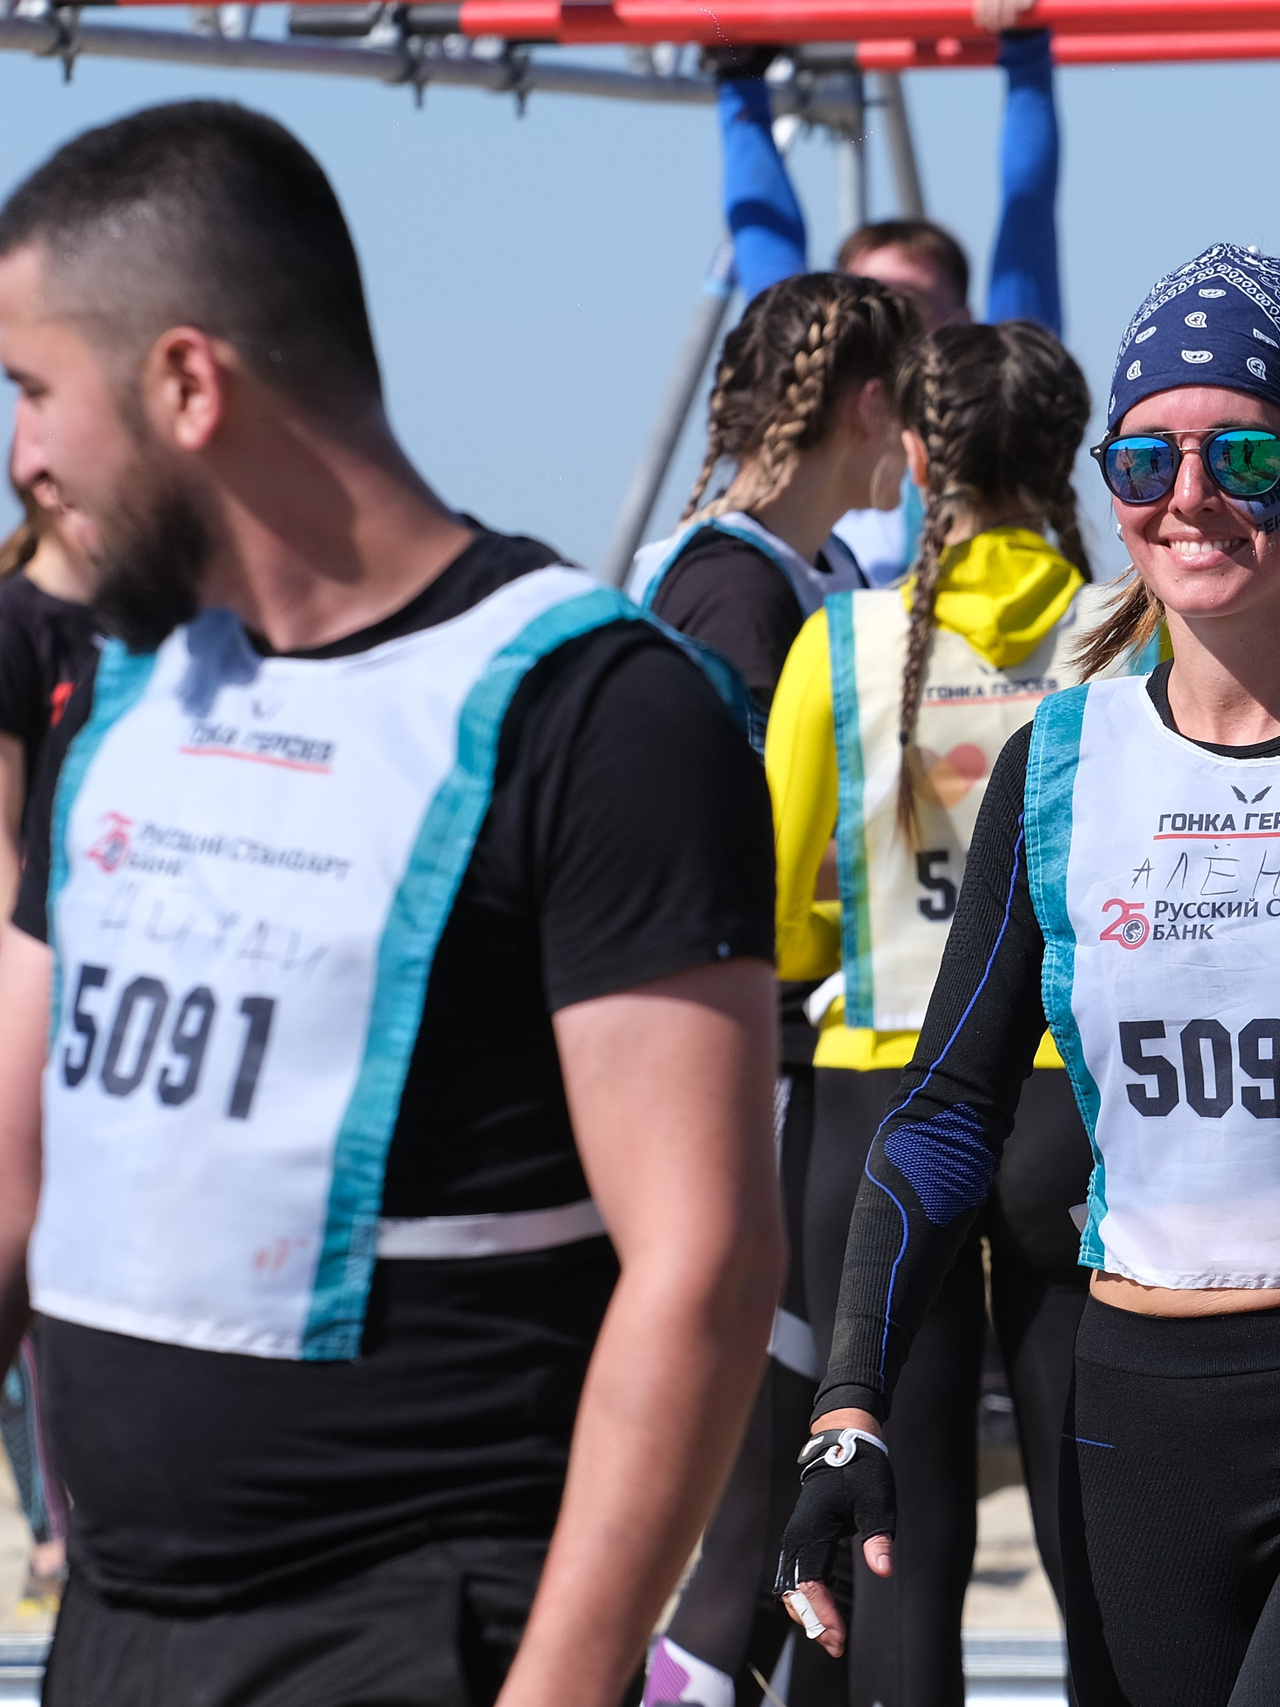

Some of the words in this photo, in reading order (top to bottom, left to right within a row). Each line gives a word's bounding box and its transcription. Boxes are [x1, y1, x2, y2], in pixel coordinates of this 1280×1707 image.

[1158, 812, 1237, 833] ГОНКА
[1152, 923, 1215, 941] БАНК
[63, 964, 277, 1121] 5091
